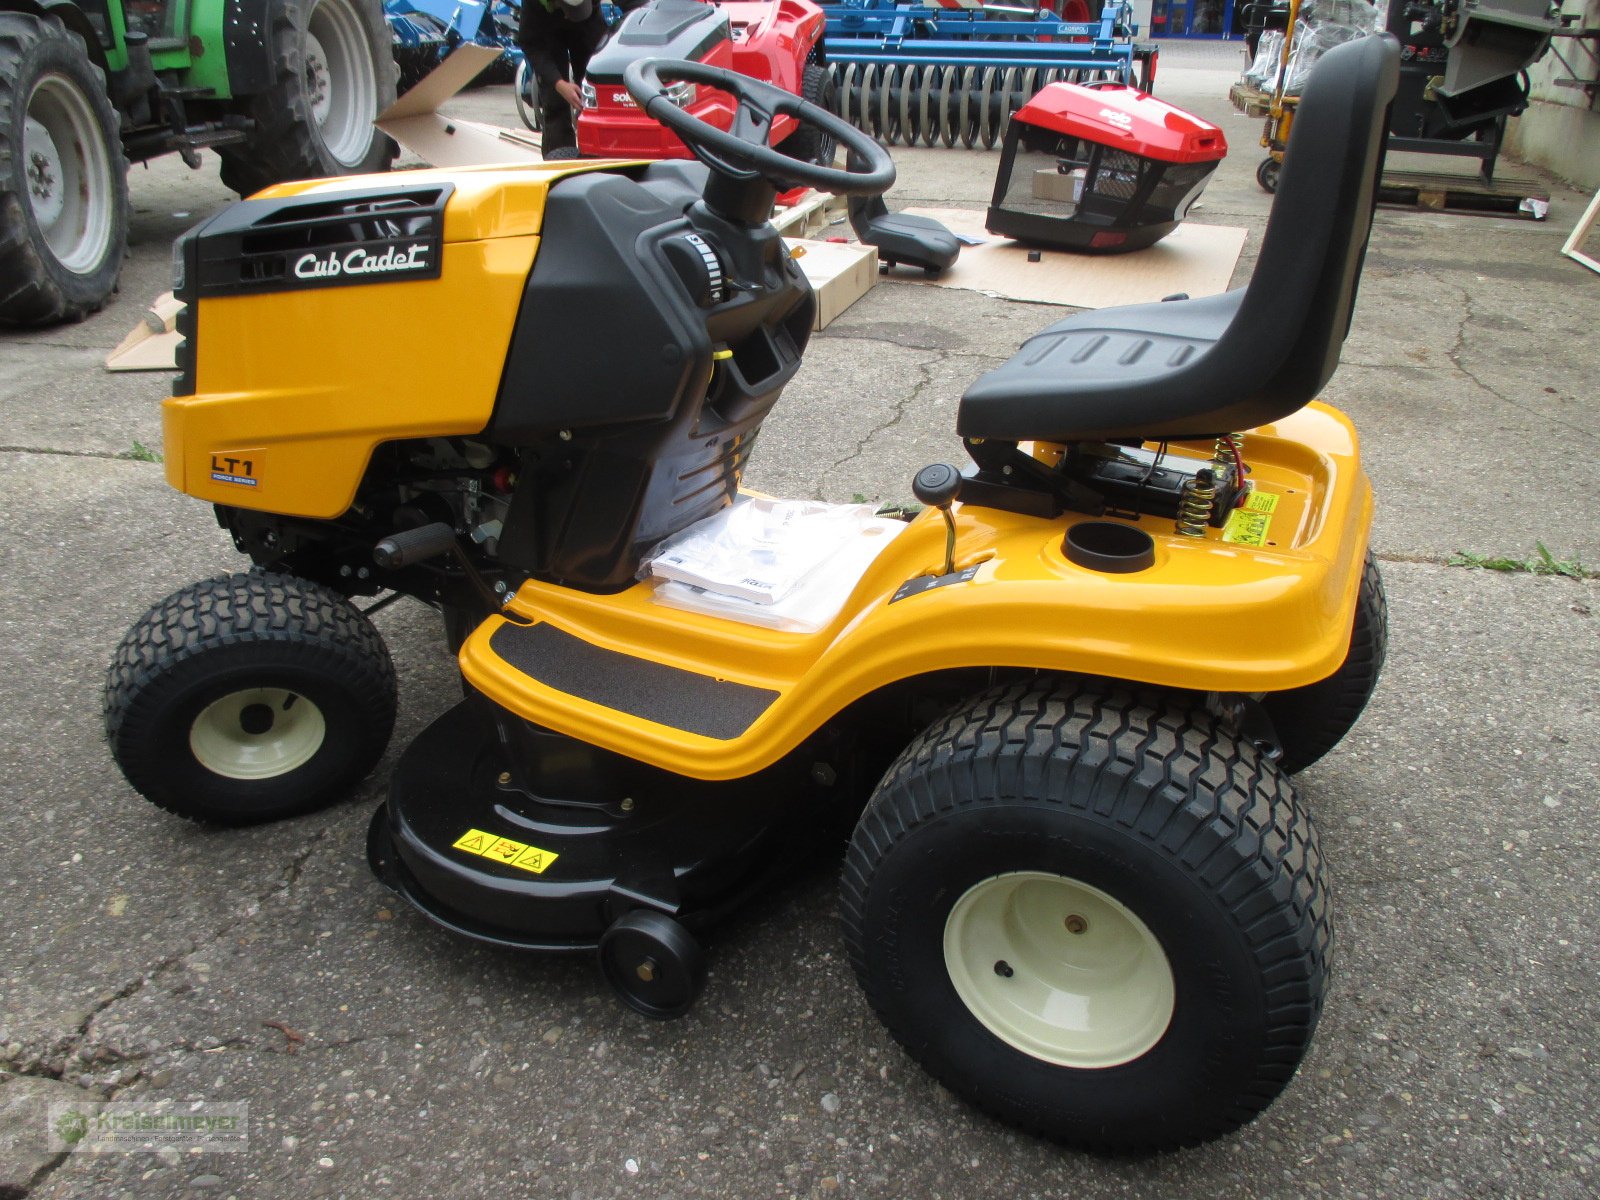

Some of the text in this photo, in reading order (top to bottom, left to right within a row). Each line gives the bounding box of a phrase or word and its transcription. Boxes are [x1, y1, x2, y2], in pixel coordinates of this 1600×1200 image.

[613, 91, 633, 102] sol
[294, 243, 429, 279] Cub Cadet
[211, 456, 253, 476] LT1
[212, 473, 257, 486] FORCE SERIES
